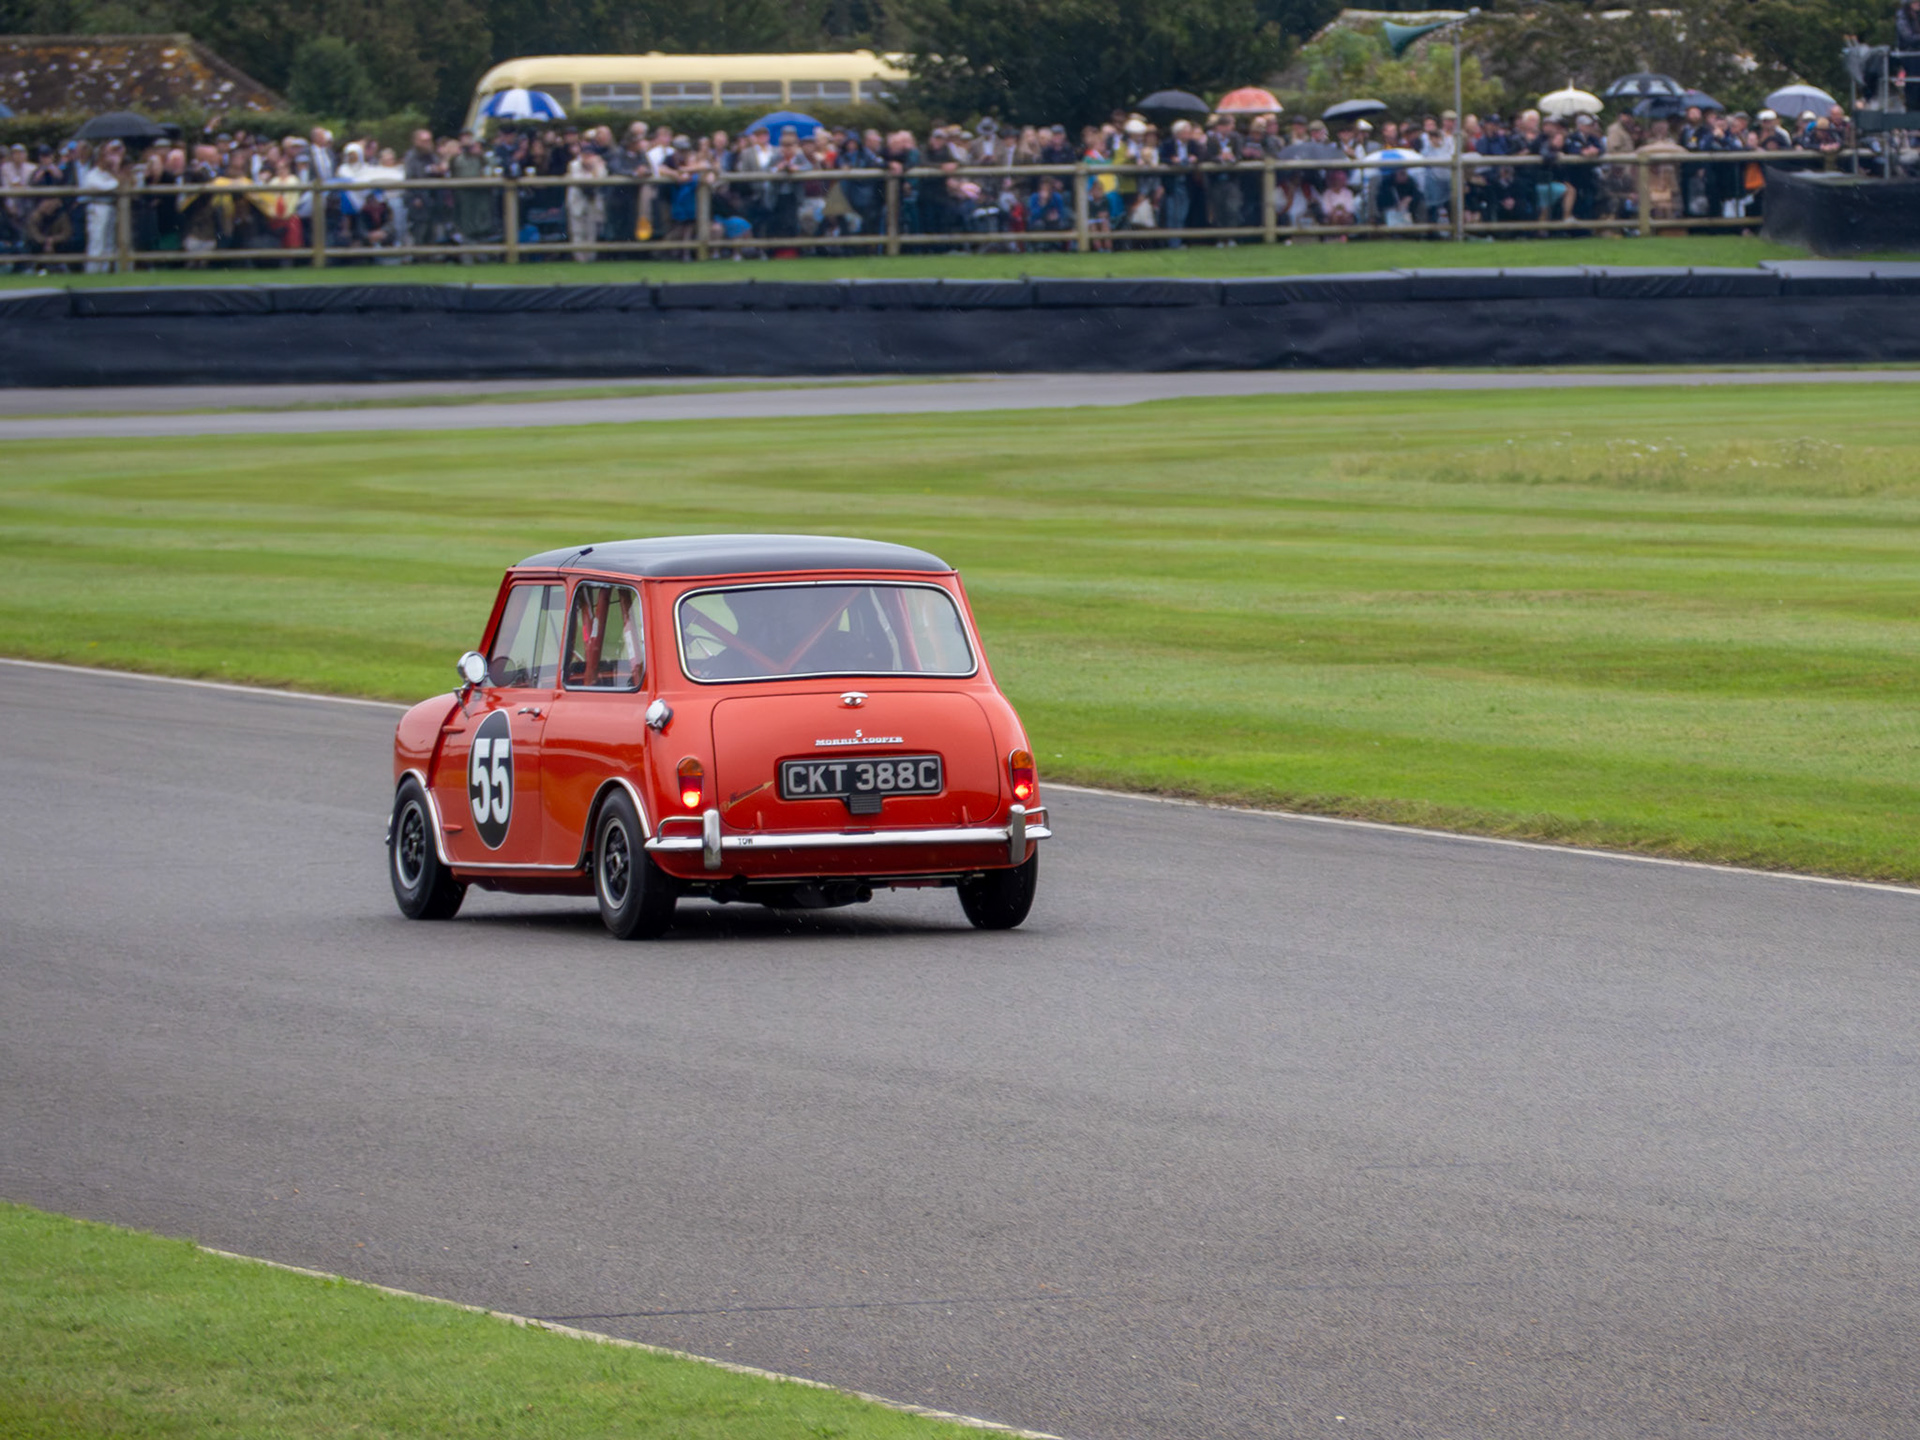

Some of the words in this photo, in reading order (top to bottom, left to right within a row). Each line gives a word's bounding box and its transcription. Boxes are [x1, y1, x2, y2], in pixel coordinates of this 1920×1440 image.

[815, 737, 859, 746] MORRIS
[855, 729, 862, 737] S
[472, 738, 510, 824] 55
[788, 764, 848, 793] CKT
[855, 761, 938, 791] 388C
